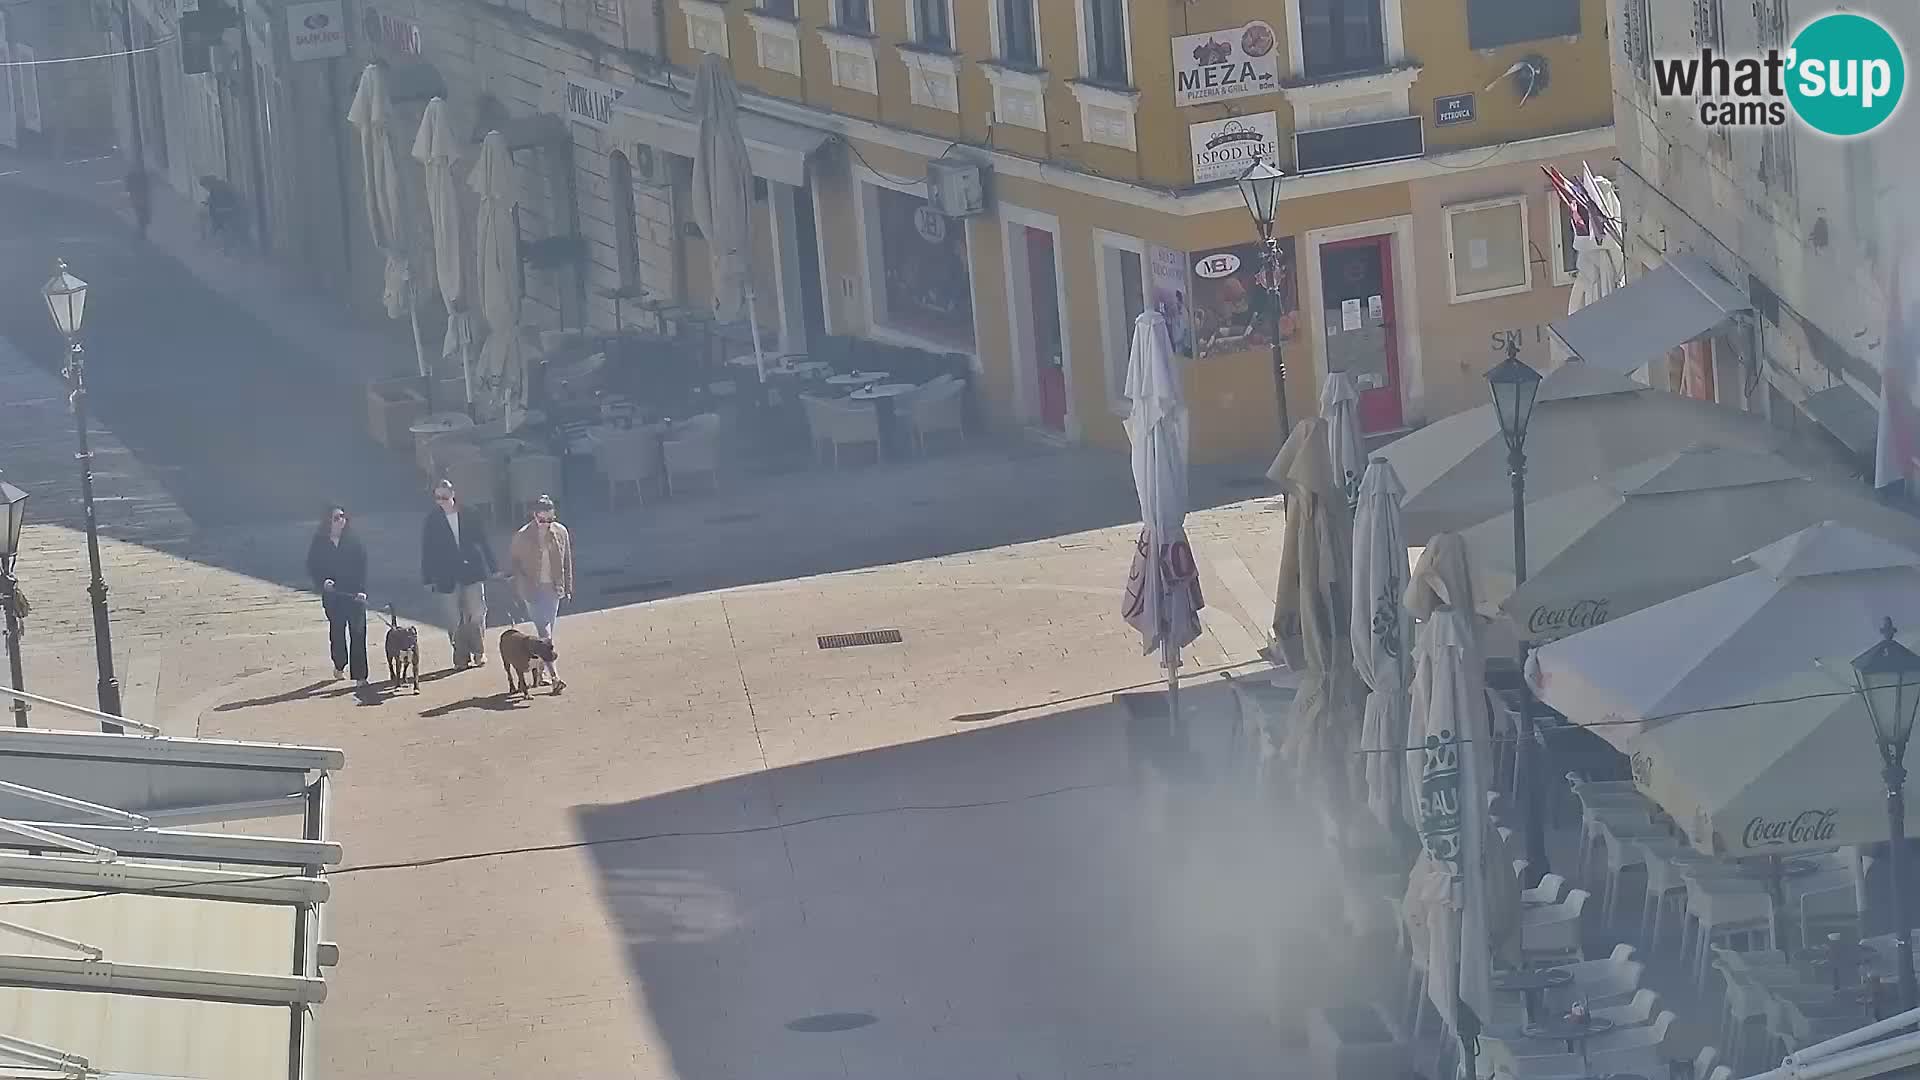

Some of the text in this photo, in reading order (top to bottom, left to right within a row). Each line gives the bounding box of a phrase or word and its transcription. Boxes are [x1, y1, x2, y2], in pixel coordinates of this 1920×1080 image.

[1178, 61, 1257, 92] MEZA
[1187, 88, 1220, 100] PIZZERIA
[1227, 83, 1249, 94] GRILL
[1196, 147, 1242, 165] ISPOD
[1528, 598, 1609, 633] Coca-Cola
[1742, 808, 1839, 848] Coca-Cola
